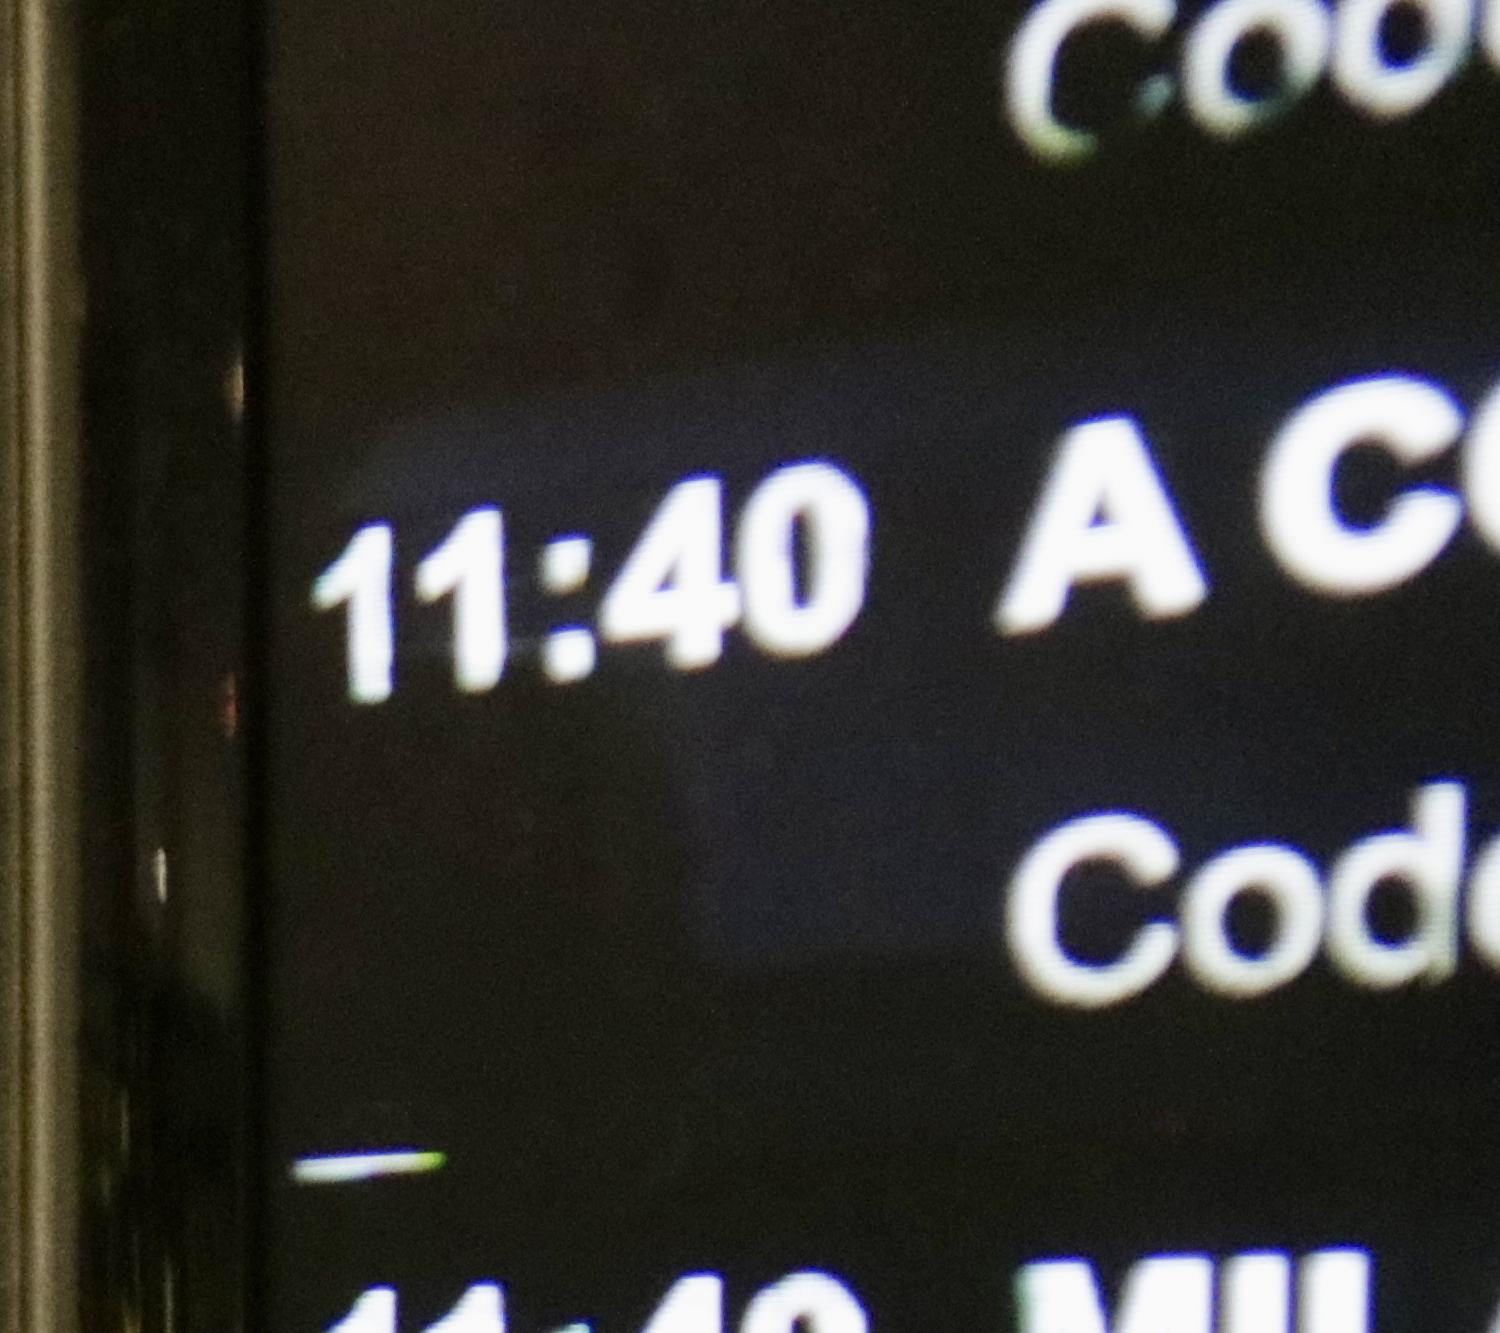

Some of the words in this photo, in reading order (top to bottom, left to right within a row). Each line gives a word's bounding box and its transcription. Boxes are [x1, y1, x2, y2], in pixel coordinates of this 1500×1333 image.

[1009, 0, 1500, 153] Cod
[315, 458, 872, 701] 11:40
[999, 412, 1208, 633] A
[1262, 371, 1500, 593] C
[1009, 778, 1500, 1005] Cod
